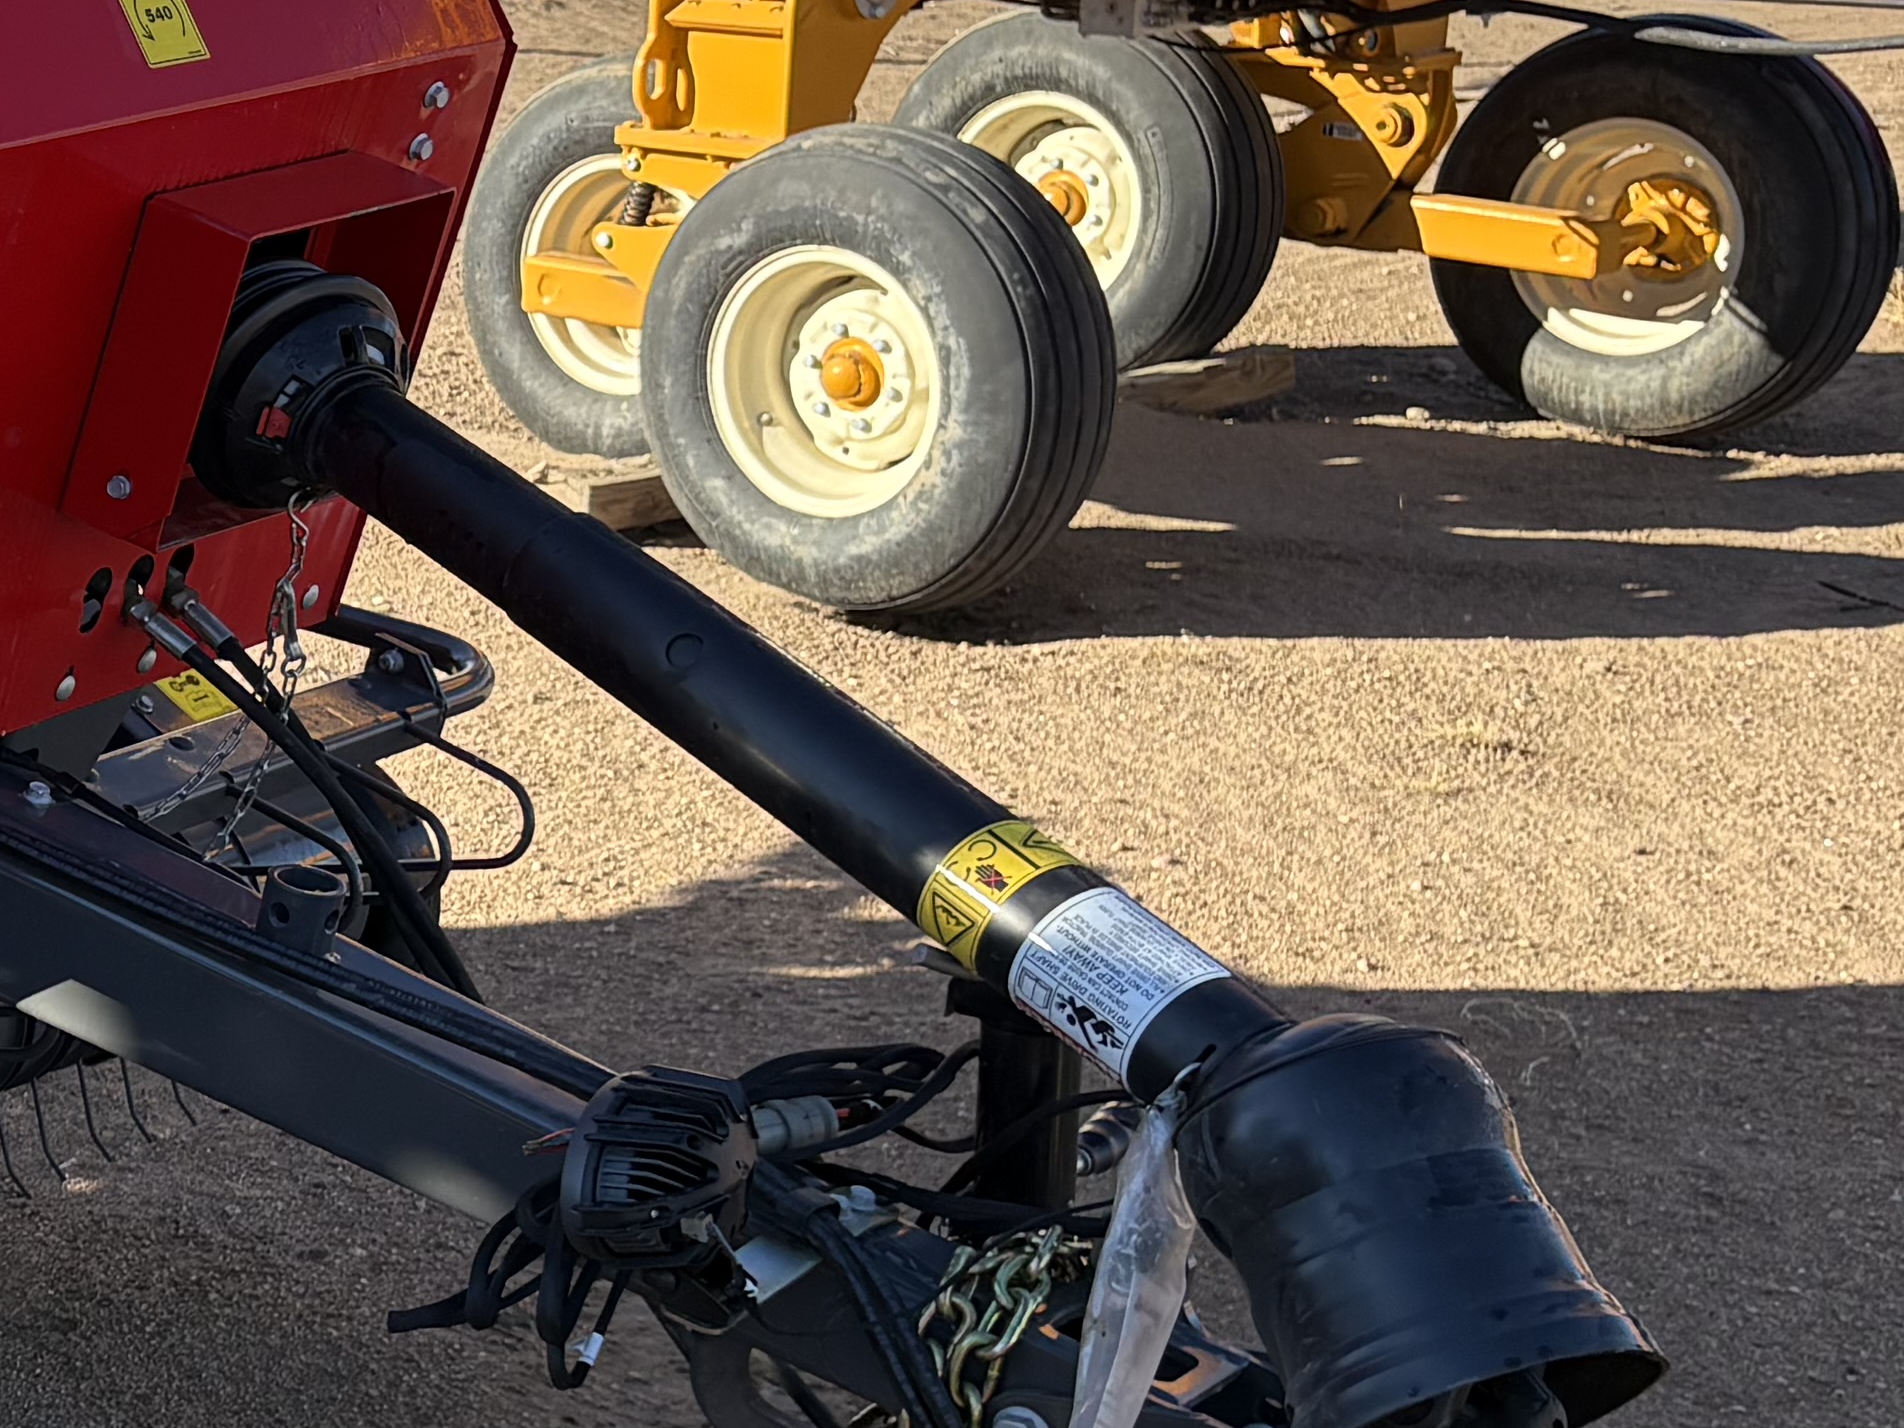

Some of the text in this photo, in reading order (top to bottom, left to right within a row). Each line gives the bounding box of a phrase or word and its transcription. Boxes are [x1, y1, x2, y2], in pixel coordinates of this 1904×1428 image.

[144, 6, 173, 23] 540
[1061, 942, 1128, 997] KEEP AWAY!
[1089, 948, 1126, 980] OPERATE
[1029, 948, 1132, 1030] ROTATING DRIVE SHAFT
[1124, 975, 1143, 993] NOT
[1138, 986, 1155, 1001] DO
